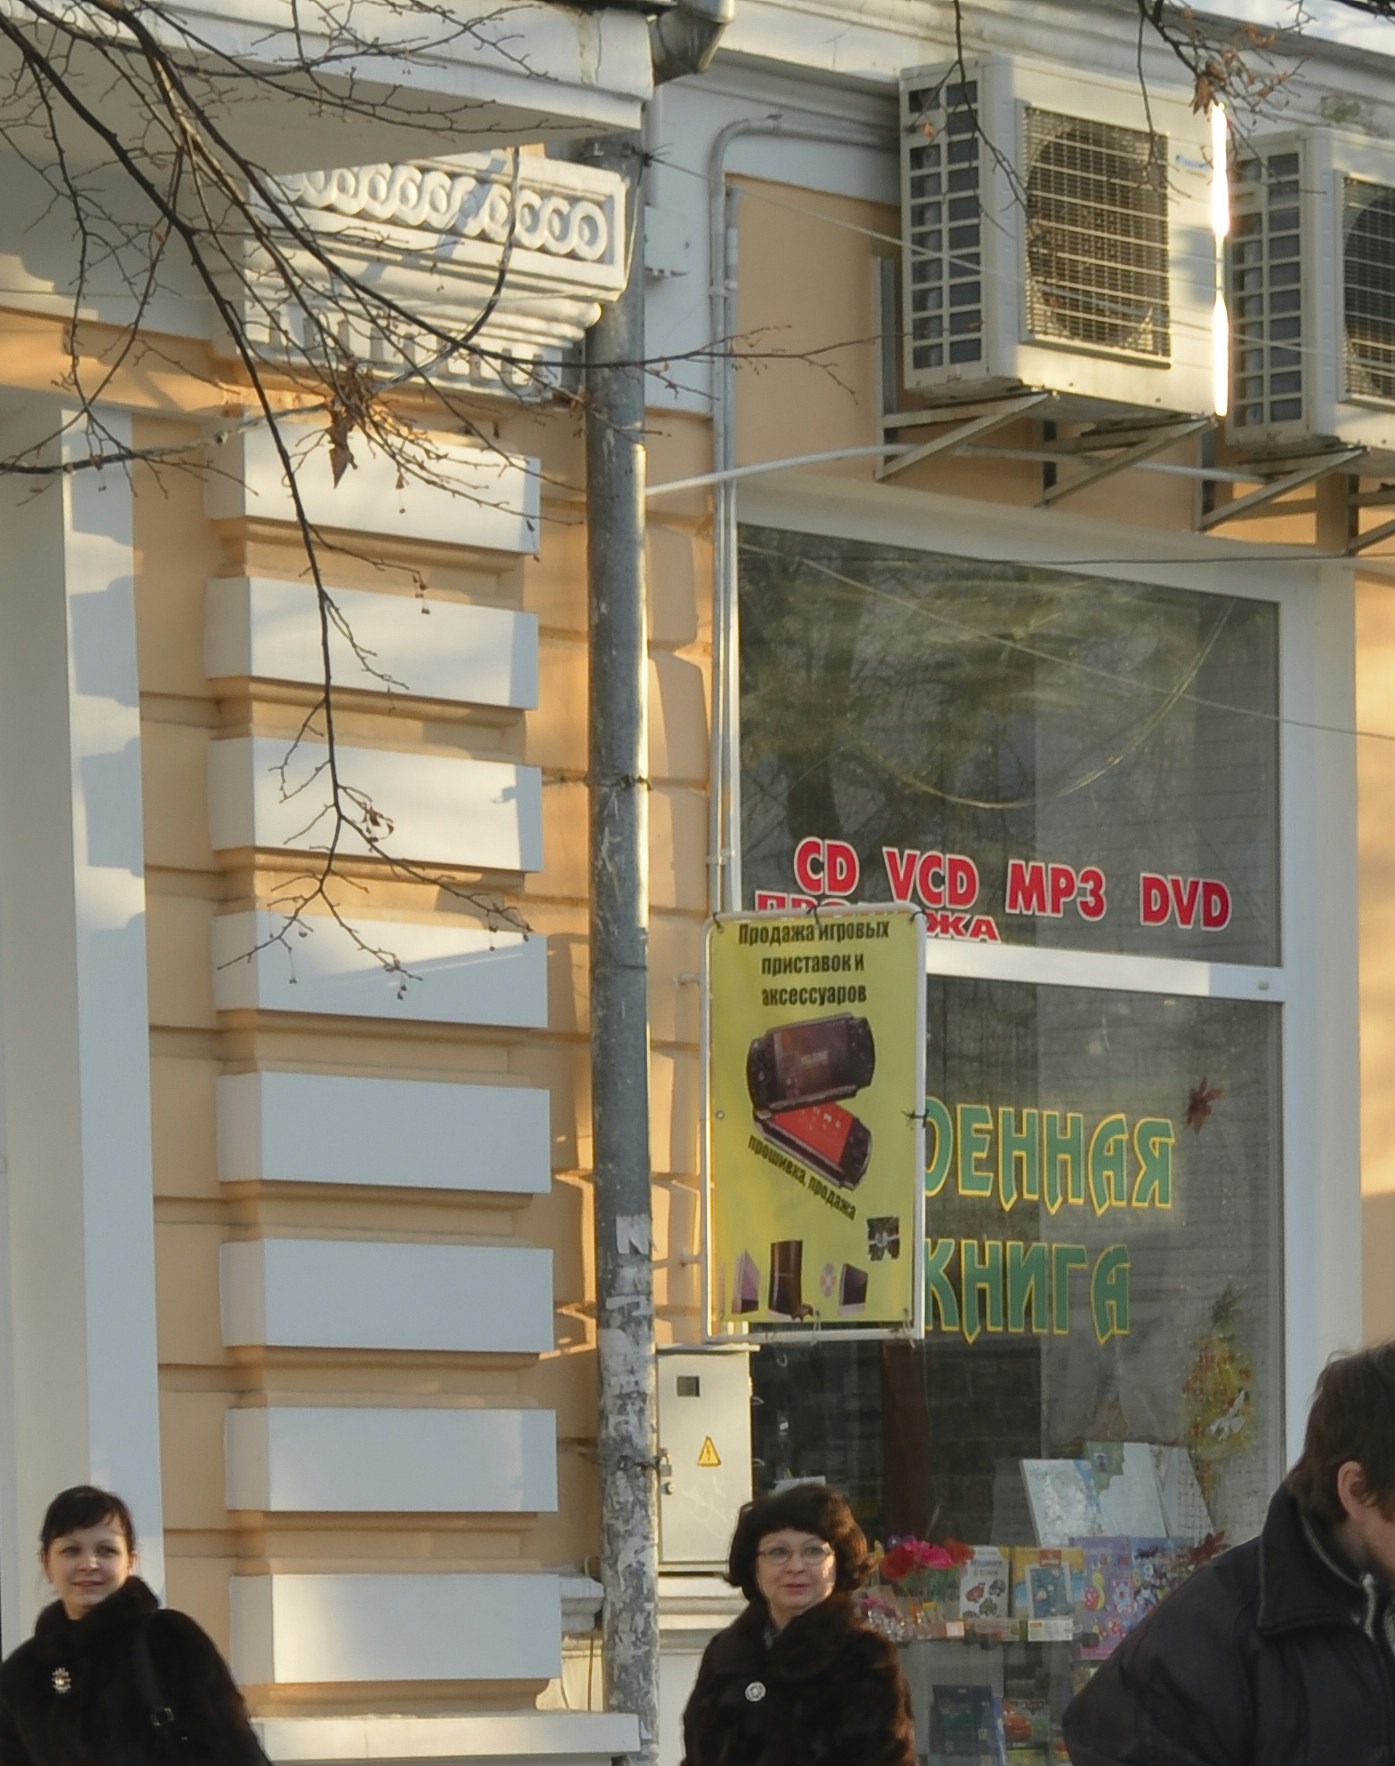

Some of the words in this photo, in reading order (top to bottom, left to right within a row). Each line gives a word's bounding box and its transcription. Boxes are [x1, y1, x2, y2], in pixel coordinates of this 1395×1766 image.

[793, 836, 860, 897] CD
[882, 846, 980, 910] VCD
[1005, 859, 1108, 922] MP3
[1140, 872, 1232, 932] DVD
[738, 923, 815, 947] Продажа
[818, 920, 889, 943] игровых
[761, 954, 851, 977] приставок
[854, 953, 865, 973] и
[761, 984, 868, 1008] аксессуаров
[925, 1096, 1175, 1216] ОЕННАЯ
[807, 1175, 857, 1221] продажа
[925, 1238, 1131, 1345] КНИГА
